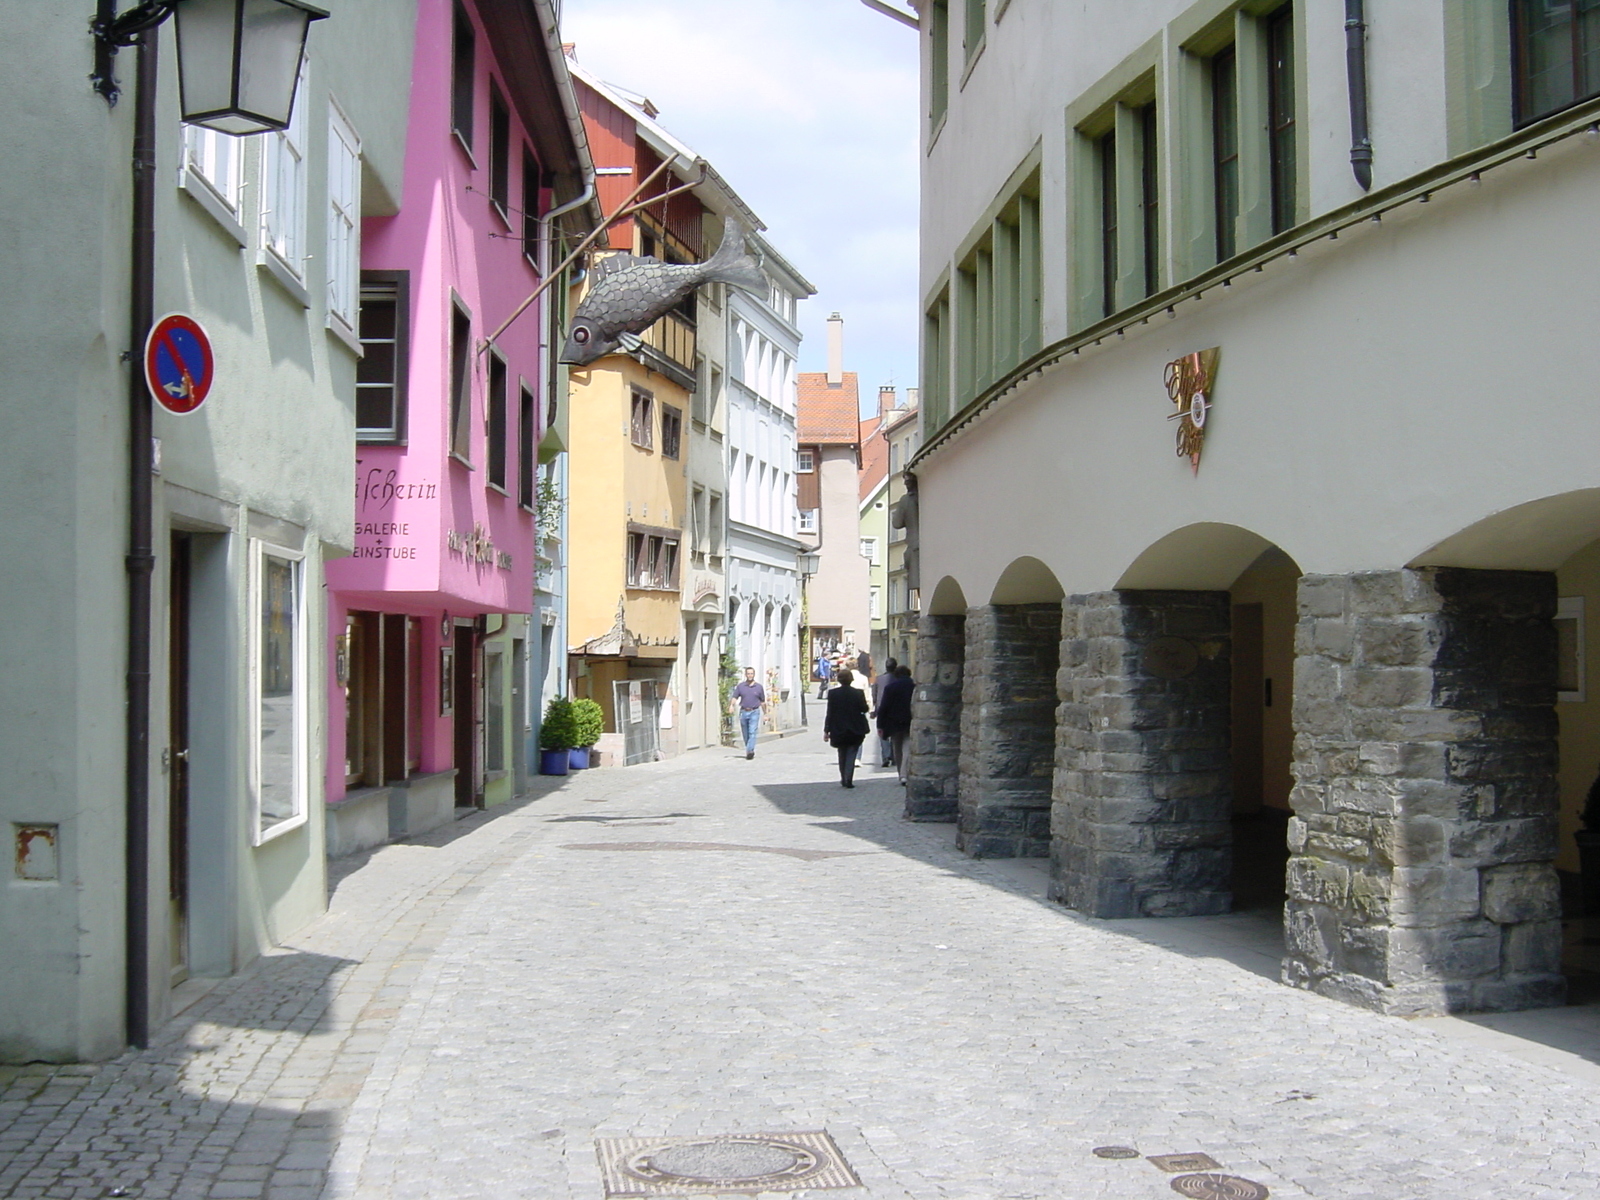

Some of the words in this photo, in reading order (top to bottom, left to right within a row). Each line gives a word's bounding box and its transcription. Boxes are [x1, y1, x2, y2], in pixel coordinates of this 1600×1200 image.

[355, 460, 436, 512] ischerin
[355, 522, 409, 535] GALERIE
[353, 546, 416, 559] EINSTUBE
